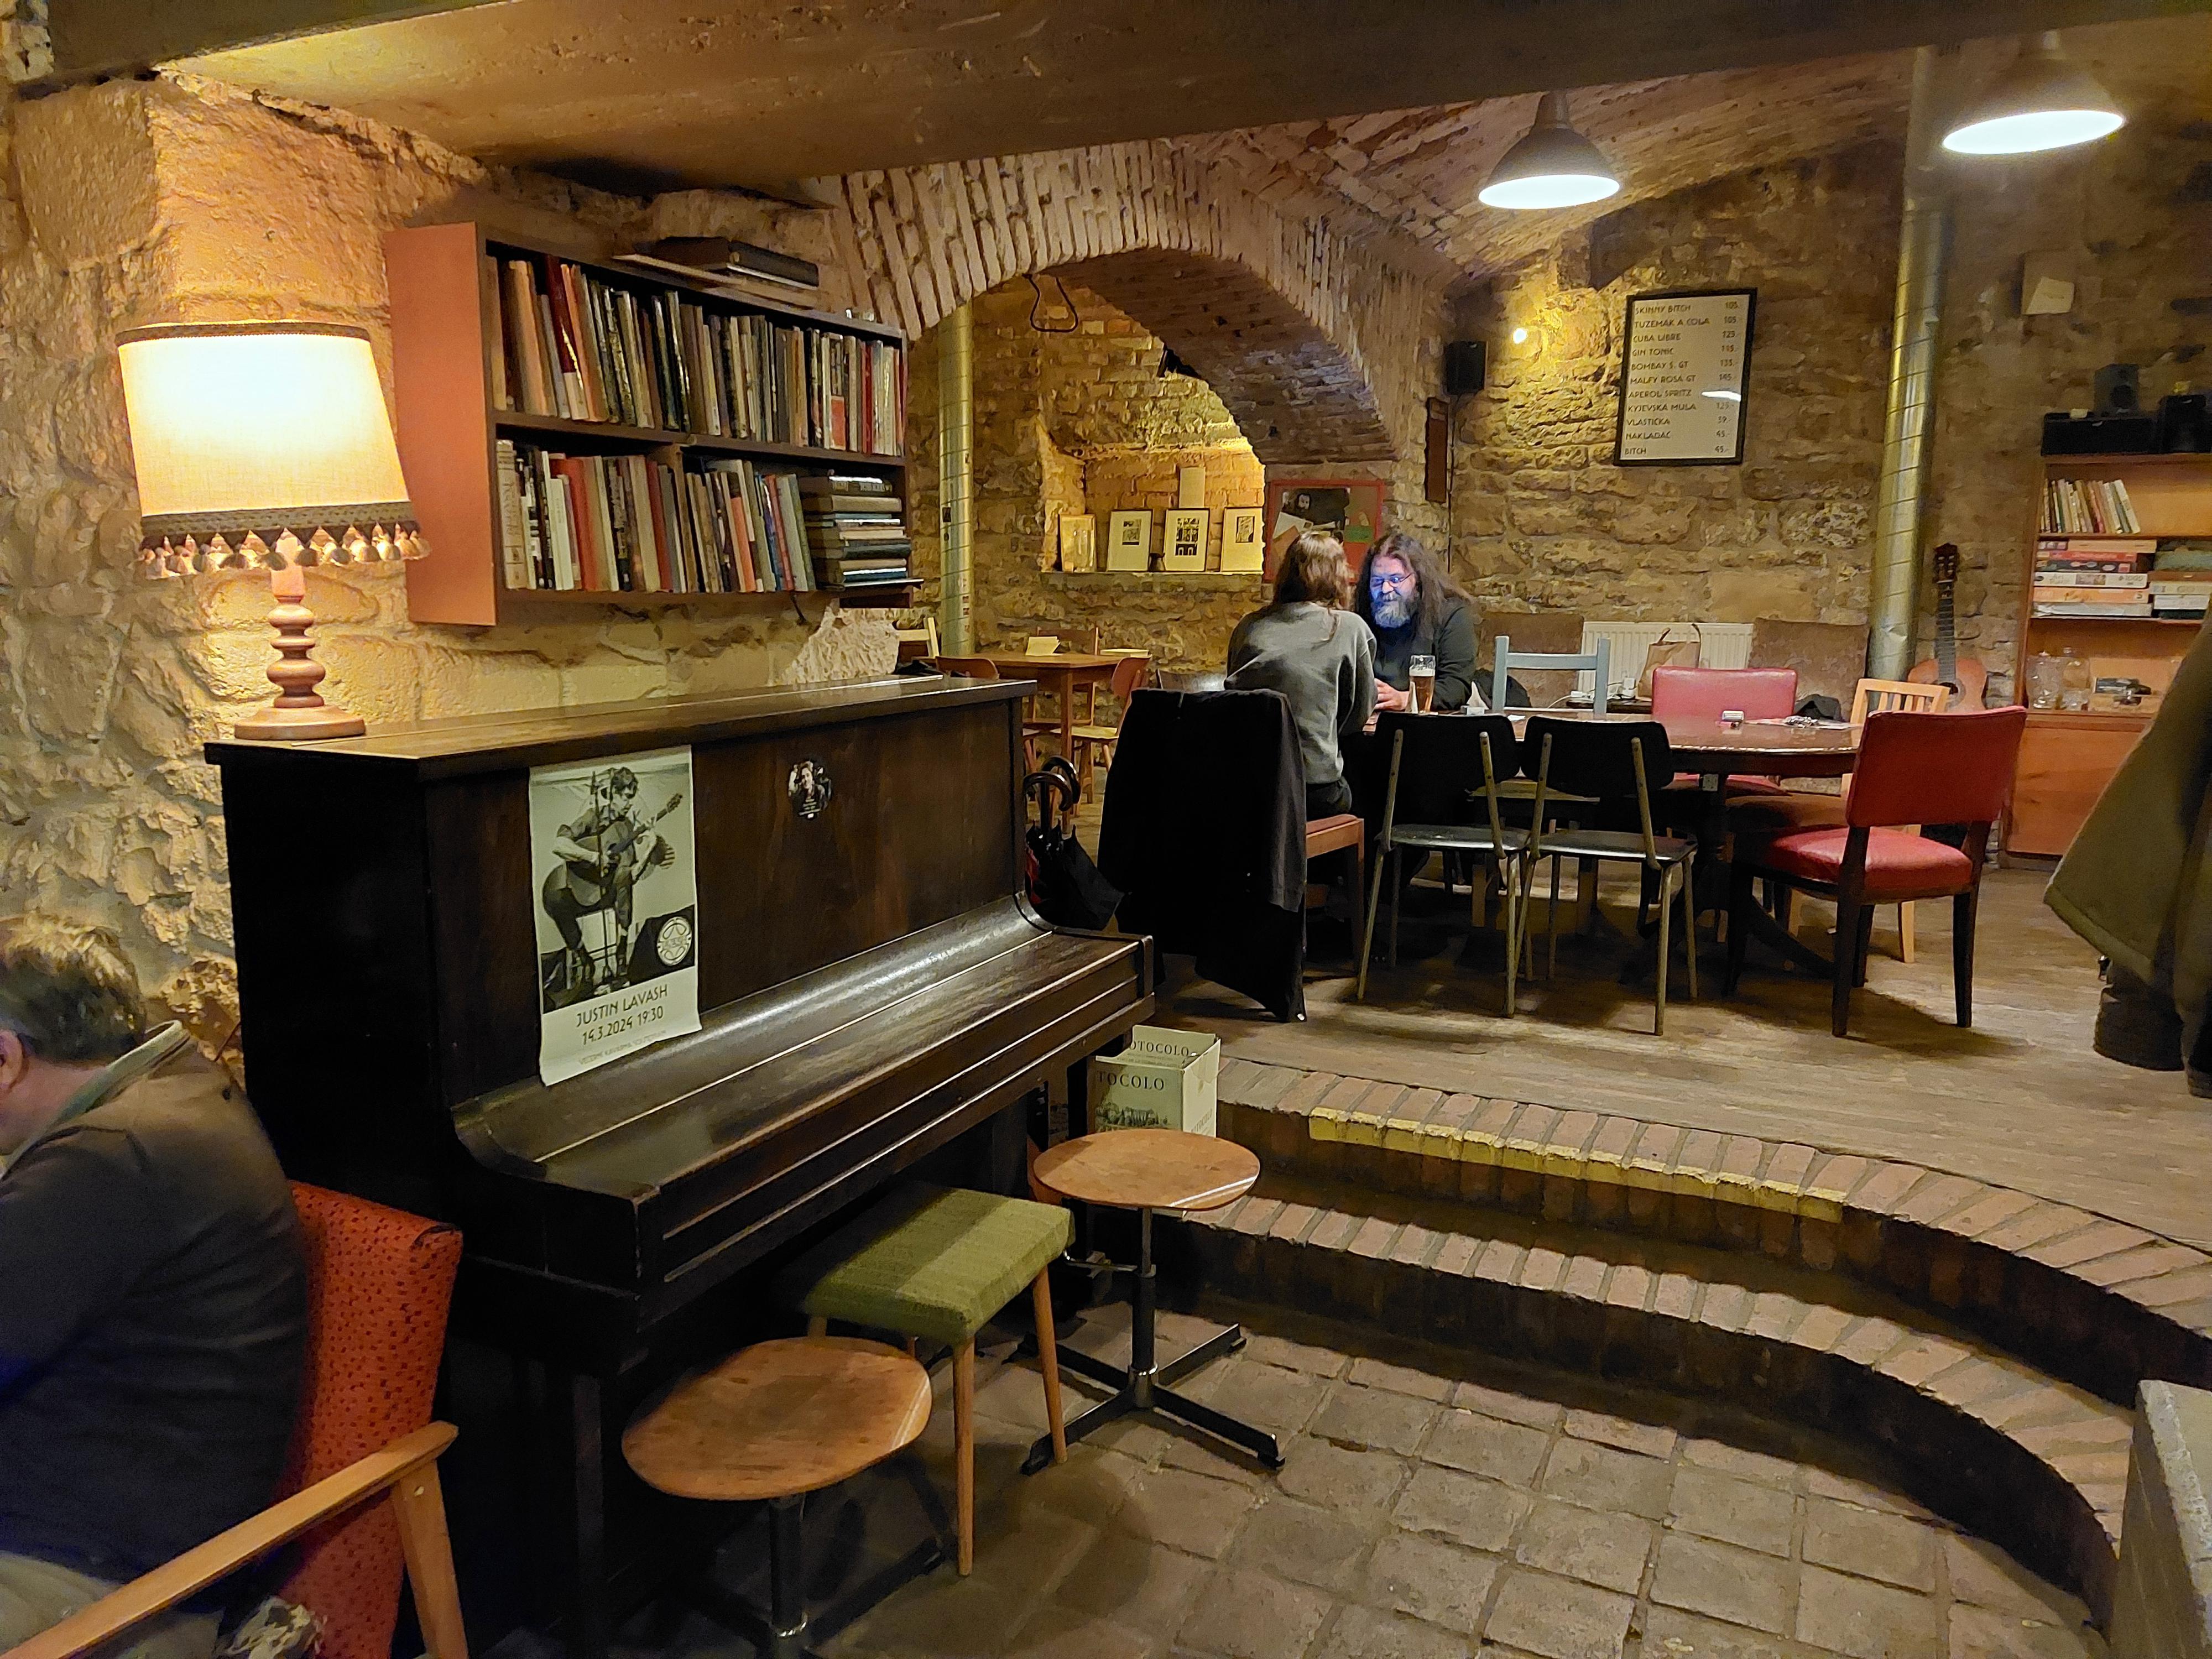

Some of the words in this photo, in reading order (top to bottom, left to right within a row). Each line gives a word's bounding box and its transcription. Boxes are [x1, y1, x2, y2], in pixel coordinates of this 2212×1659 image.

[1635, 305, 1666, 315] SKINNY
[1668, 305, 1691, 313] BITCH
[1657, 333, 1681, 341] LIBRE
[1631, 362, 1667, 371] BOMBAY
[1630, 376, 1658, 384] MALFY
[1628, 390, 1662, 398] APEROL
[576, 1001, 618, 1027] JUSTIN
[623, 984, 668, 1011] LAVASH
